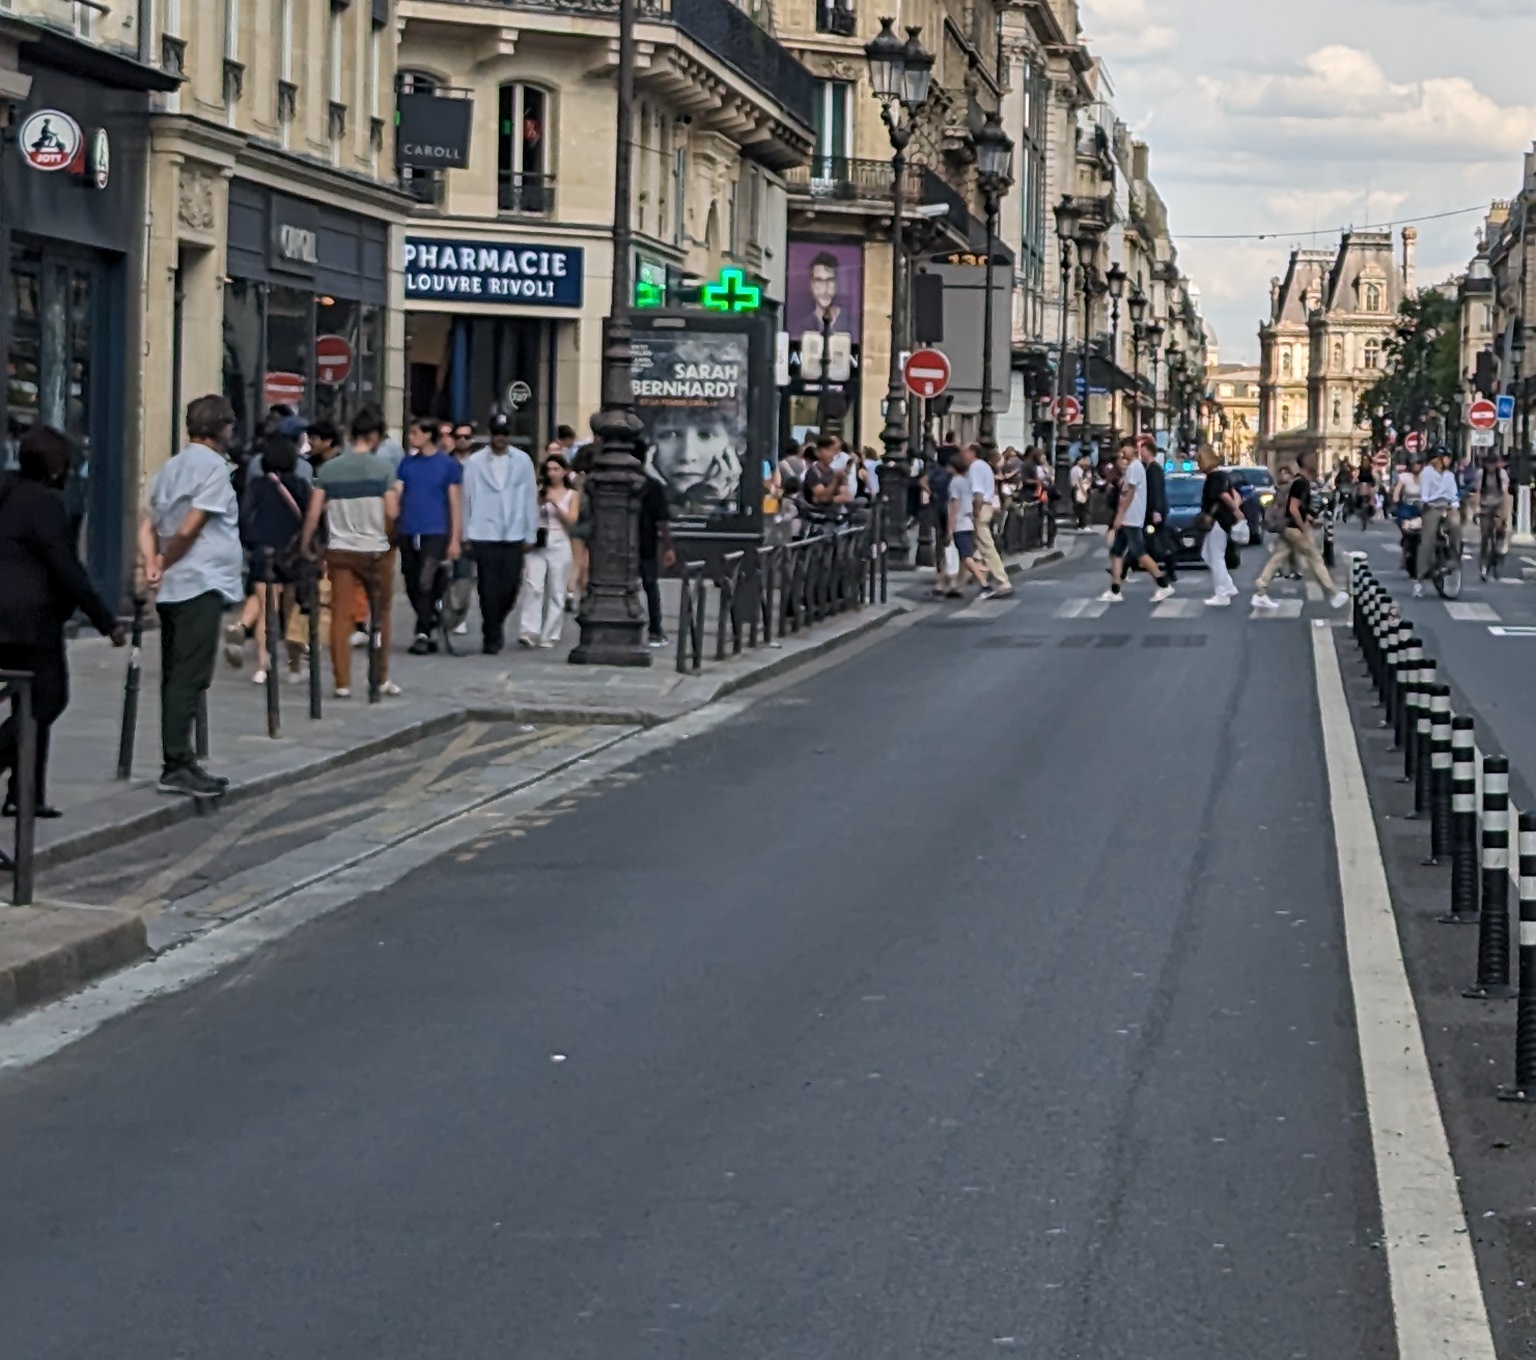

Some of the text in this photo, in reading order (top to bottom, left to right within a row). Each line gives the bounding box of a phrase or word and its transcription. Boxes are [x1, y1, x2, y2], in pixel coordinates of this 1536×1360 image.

[404, 144, 461, 160] CAROLL
[404, 243, 567, 277] PHARMACIE
[407, 273, 555, 298] LOUVRE RIVOLI
[673, 363, 739, 380] SARAH
[631, 380, 738, 399] BERNHARDT
